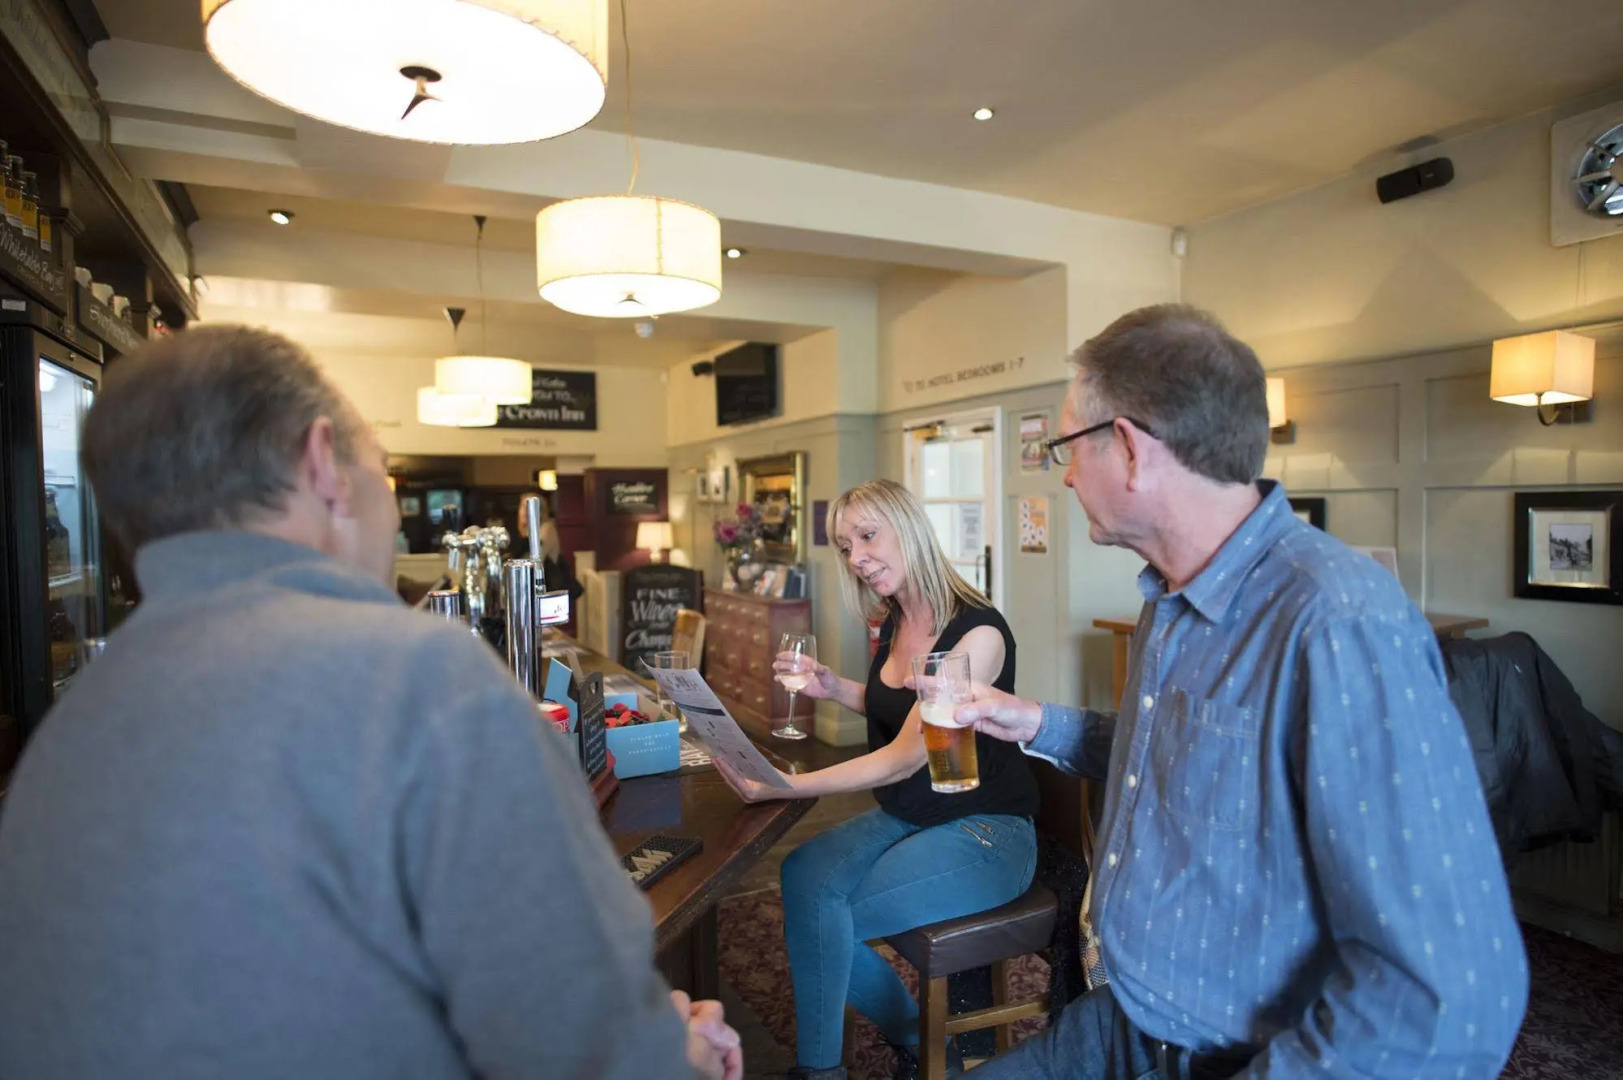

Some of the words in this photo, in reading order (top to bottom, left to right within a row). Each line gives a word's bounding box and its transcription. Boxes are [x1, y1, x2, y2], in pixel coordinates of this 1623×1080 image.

[956, 361, 1005, 382] BEDROOMS
[504, 404, 560, 423] Crown
[561, 404, 586, 423] Inn
